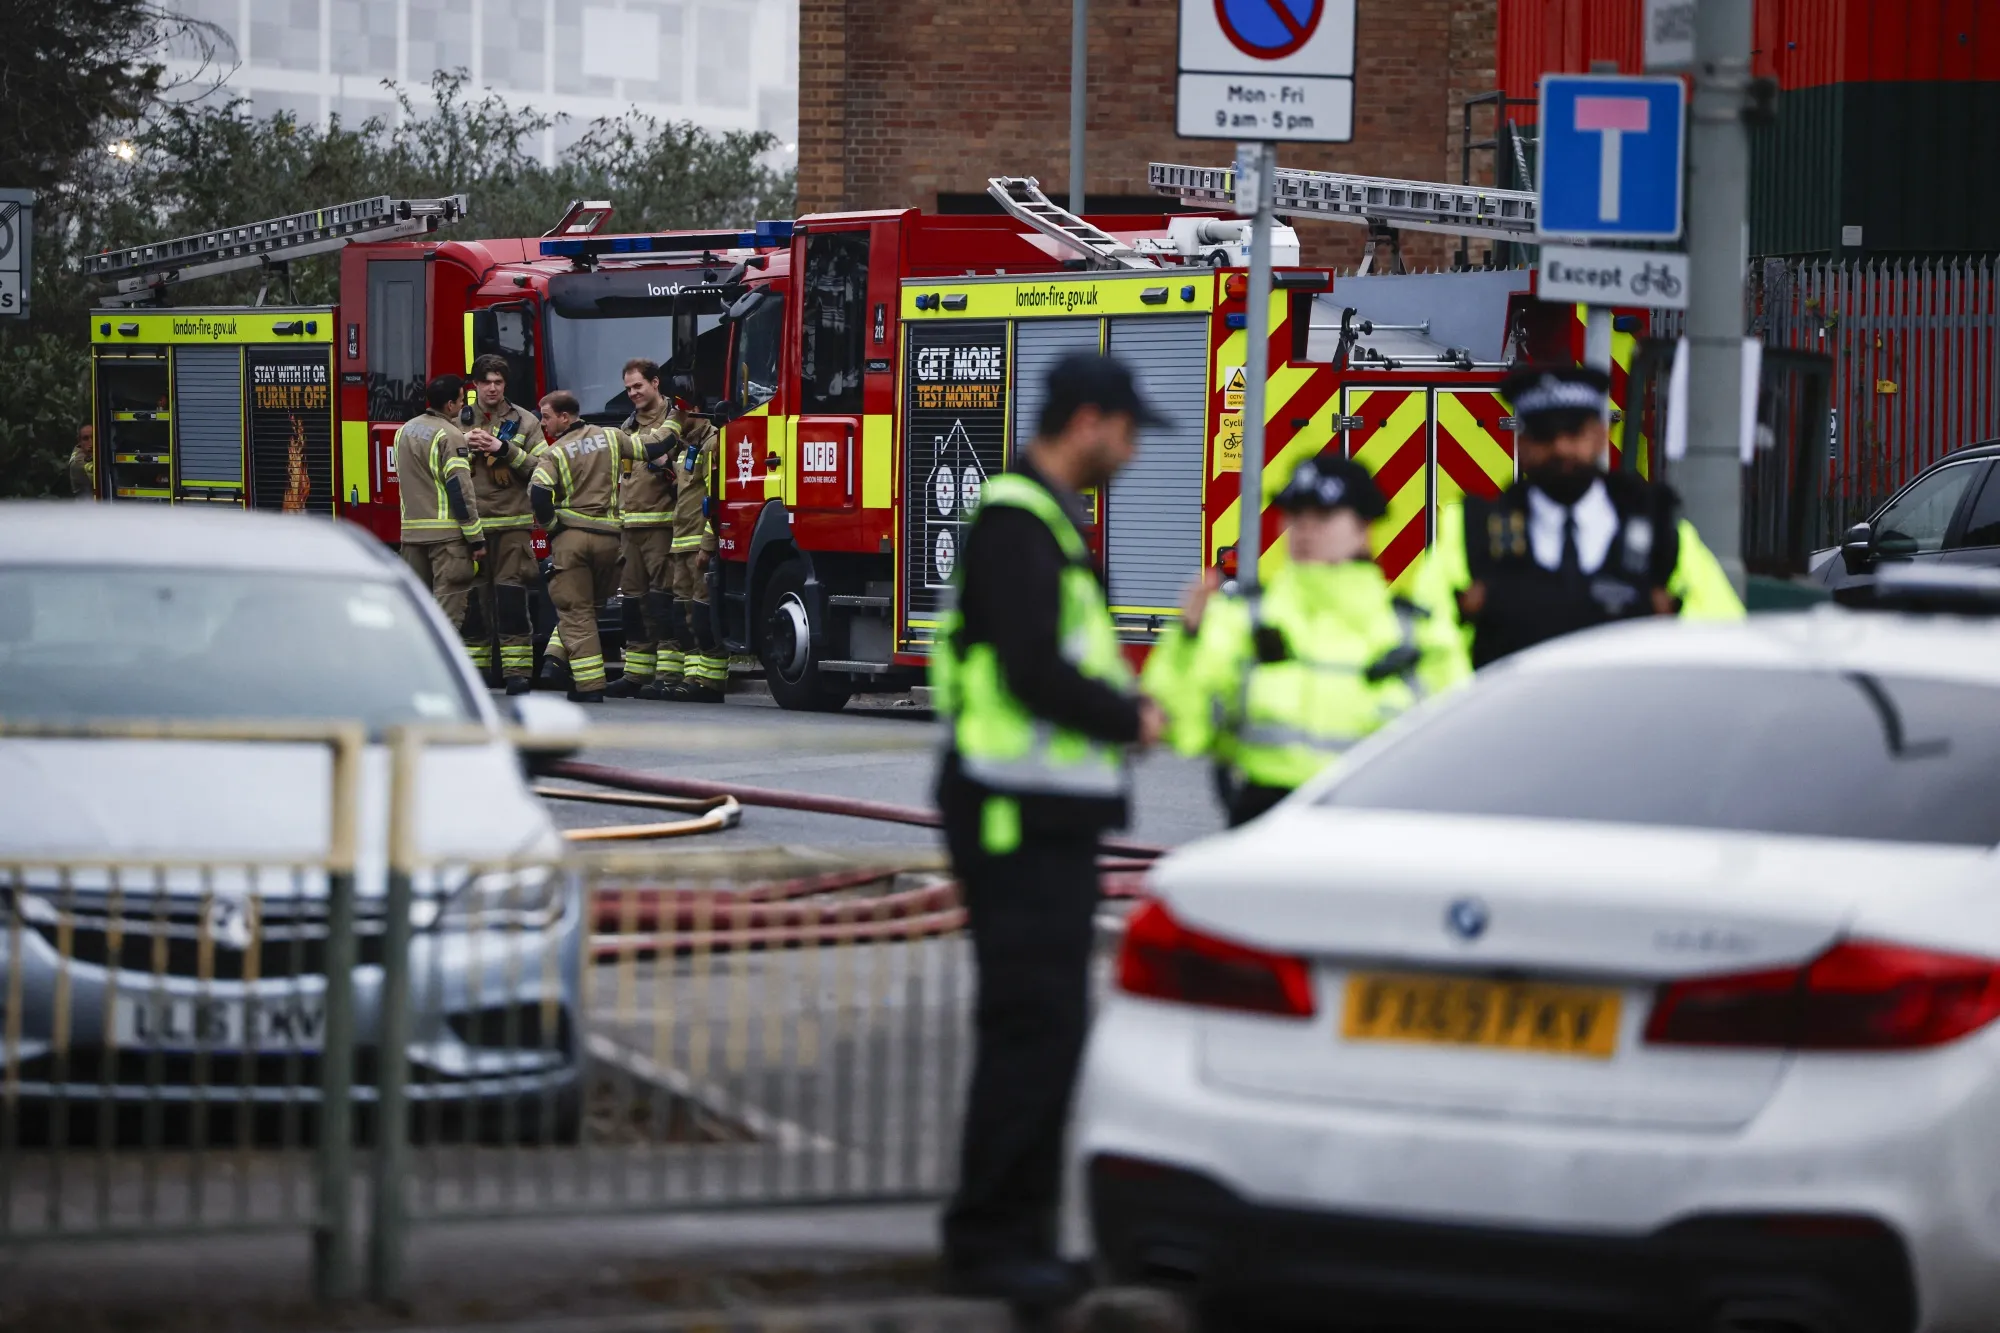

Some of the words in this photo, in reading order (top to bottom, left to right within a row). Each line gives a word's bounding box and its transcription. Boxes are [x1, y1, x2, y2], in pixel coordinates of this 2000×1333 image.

[1228, 85, 1266, 102] Mon
[1281, 85, 1304, 103] Fri
[1548, 261, 1621, 290] Except
[1016, 285, 1098, 312] london-fire.gov.uk
[173, 318, 237, 340] london-fire.gov.uk
[254, 365, 276, 383] STAY
[277, 365, 301, 383] WITH
[303, 365, 311, 383] IT
[313, 365, 326, 383] OR
[917, 347, 950, 381] GET
[953, 346, 1001, 380] MORE
[255, 385, 288, 409] TURN
[290, 385, 301, 409] IT
[304, 385, 326, 409] OFF
[917, 384, 943, 408] TEST
[945, 384, 1000, 408] MONTHLY
[1224, 419, 1245, 427] Cycli
[565, 434, 608, 458] FIRE
[806, 446, 835, 466] LFB
